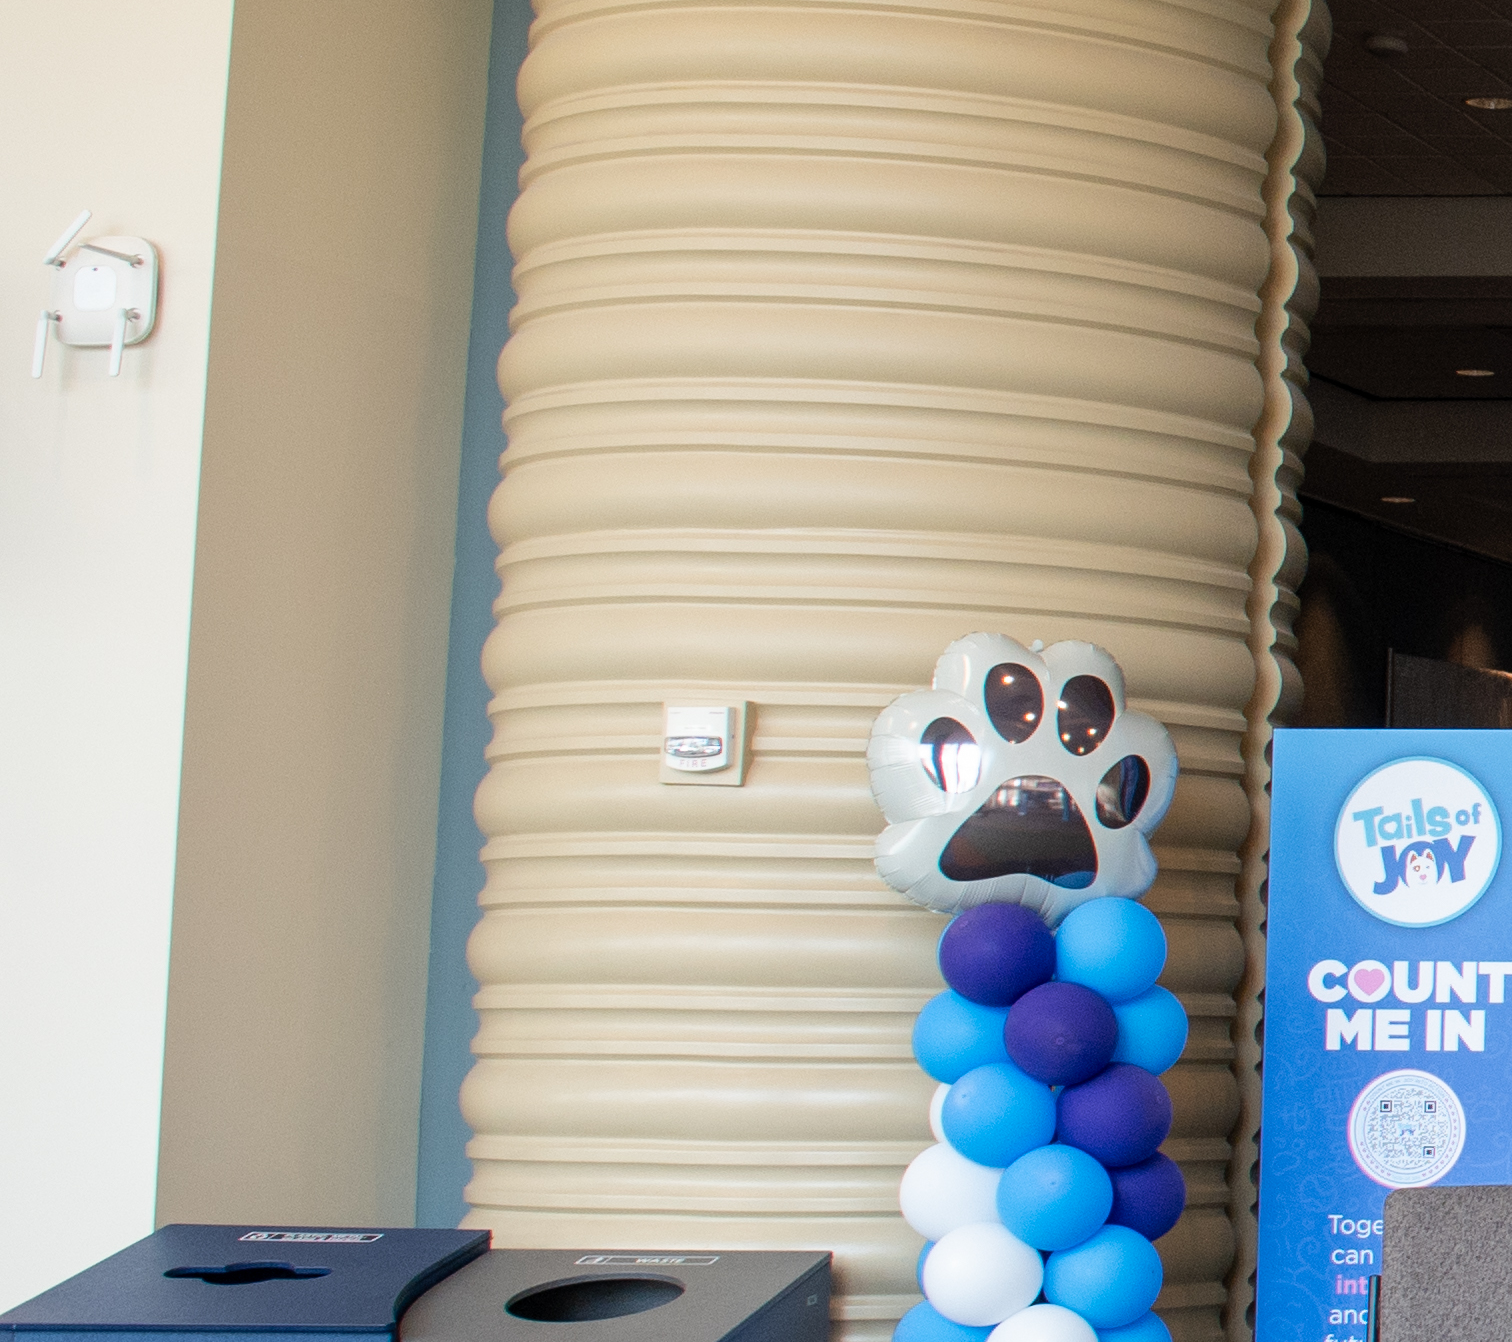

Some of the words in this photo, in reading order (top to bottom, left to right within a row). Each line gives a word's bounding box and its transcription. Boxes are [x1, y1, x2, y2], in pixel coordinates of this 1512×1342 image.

[680, 759, 707, 768] FIRE
[1352, 798, 1453, 847] Tails
[1455, 803, 1482, 826] of
[1373, 834, 1476, 896] JOY
[1325, 1008, 1411, 1051] ME
[1425, 1009, 1486, 1052] IN
[1331, 1248, 1374, 1265] can
